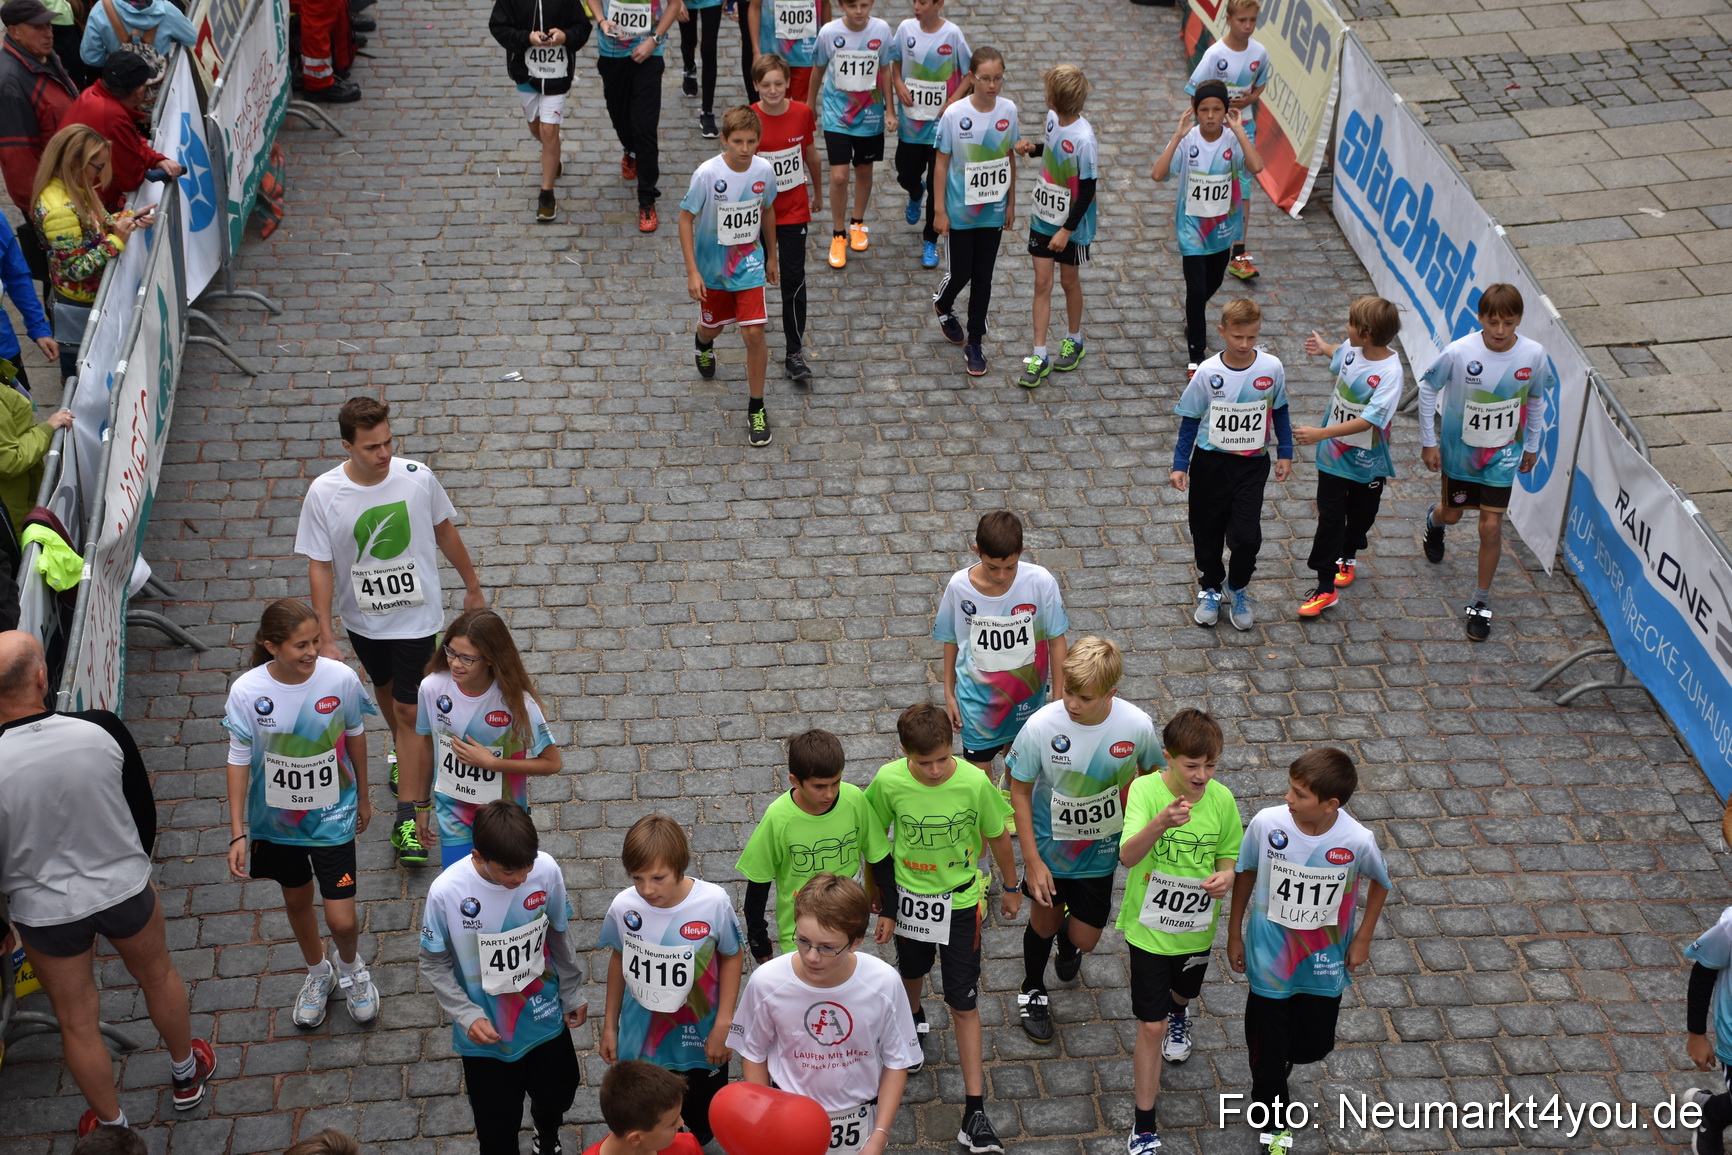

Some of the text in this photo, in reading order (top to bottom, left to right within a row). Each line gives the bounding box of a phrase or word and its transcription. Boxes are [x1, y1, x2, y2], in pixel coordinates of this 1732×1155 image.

[612, 12, 647, 28] 4020
[780, 10, 813, 25] 4003
[529, 48, 565, 63] 4024
[840, 60, 874, 76] 4112
[775, 151, 796, 160] Neumarkt
[774, 156, 799, 177] 026
[970, 168, 1007, 188] 4016
[978, 189, 999, 198] Marike
[1034, 188, 1065, 212] 4015
[1191, 184, 1230, 202] 4102
[736, 203, 756, 211] Neumarkt
[723, 209, 759, 230] 4045
[733, 231, 752, 240] Jonas
[1212, 405, 1230, 413] PARTL
[1466, 404, 1512, 413] PARTL Neumarkt
[1215, 413, 1263, 432] 4042
[1469, 410, 1515, 431] 4111
[1221, 436, 1255, 444] Jonathan
[352, 565, 406, 577] PARTL Neumarkt
[361, 572, 415, 597] 4109
[1569, 505, 1595, 545] AUF
[1593, 536, 1625, 600] JEDER
[1622, 586, 1680, 676] STRECKE
[372, 600, 412, 611] Maxim
[992, 619, 1022, 628] Neumarkt
[977, 626, 1029, 651] 4004
[266, 757, 326, 770] PARTL Neumarkt
[1051, 754, 1071, 762] PARTL
[272, 765, 333, 790] 4019
[455, 783, 476, 796] Anke
[291, 794, 314, 804] Sara
[1053, 794, 1109, 808] PARTL Neumarkt
[1058, 799, 1116, 826] 4030
[1077, 827, 1101, 836] Felix
[1267, 850, 1287, 860] PARTL
[1272, 864, 1335, 881] PARTL Neumarkt
[1151, 876, 1177, 889] PARTL
[1276, 878, 1340, 907] 4117
[897, 896, 945, 922] 039
[1152, 888, 1211, 915] 4029
[1159, 914, 1195, 929] Vinzenz
[1280, 905, 1328, 924] LUKAS
[896, 919, 930, 935] Hannes
[480, 925, 542, 948] PARTL Neumarkt
[490, 932, 543, 972] 4014
[625, 940, 681, 960] PARTL Neumarkt
[1314, 952, 1330, 962] 16.
[512, 969, 531, 986] Paul
[629, 955, 687, 987] 4116
[830, 1121, 860, 1149] 35
